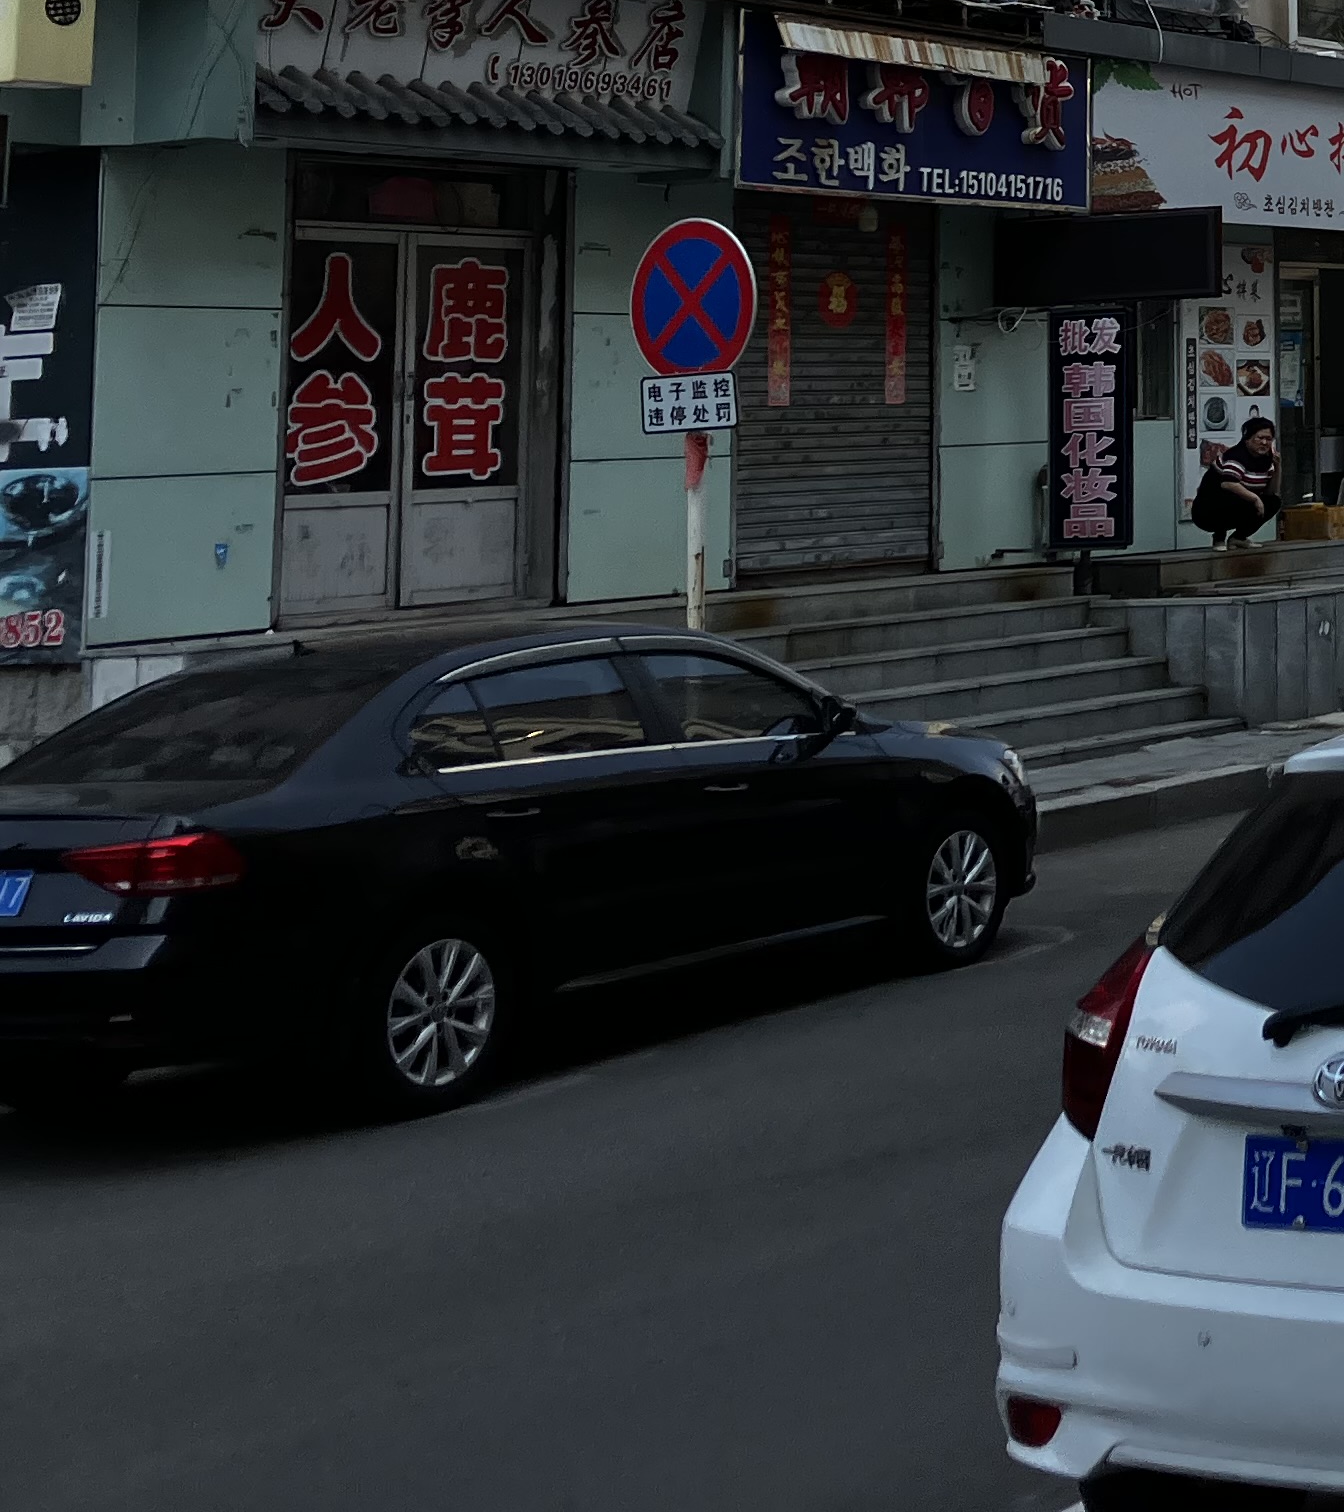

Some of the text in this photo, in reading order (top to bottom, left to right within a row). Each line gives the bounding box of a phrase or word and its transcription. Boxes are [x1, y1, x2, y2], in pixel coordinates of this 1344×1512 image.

[508, 64, 673, 101] 13019693461
[1170, 82, 1203, 100] HOT
[773, 137, 911, 192] 조한백화
[918, 166, 1064, 202] TEL:15104151716
[1262, 194, 1335, 219] 초심김치반찬
[1057, 316, 1122, 356] 批发
[287, 252, 382, 487] 人参
[422, 256, 510, 481] 鹿茸
[648, 378, 731, 403] 电子监控
[648, 402, 731, 427] 违停处罚
[1059, 360, 1118, 539] 韩国化妆品
[63, 911, 114, 924] LAVIDA
